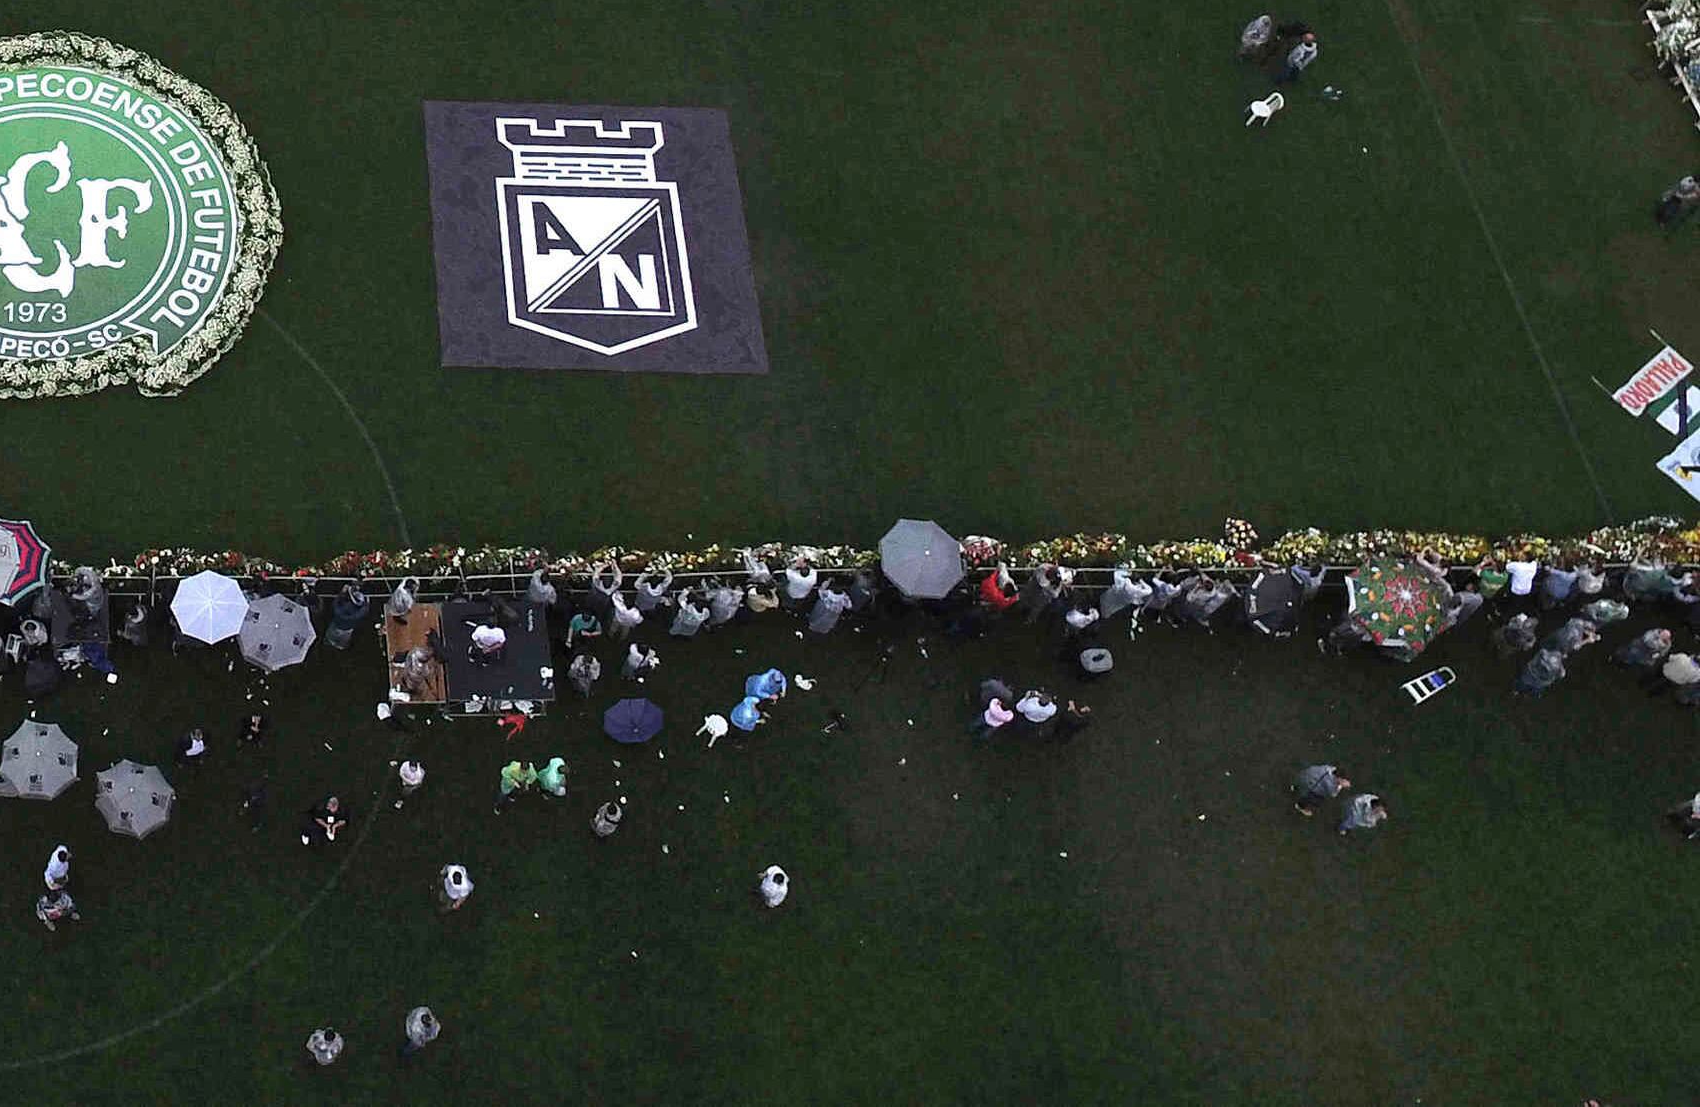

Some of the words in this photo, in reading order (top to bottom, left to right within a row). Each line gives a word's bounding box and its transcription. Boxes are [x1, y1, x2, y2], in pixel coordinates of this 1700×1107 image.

[169, 140, 216, 192] DE
[149, 185, 225, 329] FUTEBOL
[3, 302, 68, 324] 1973
